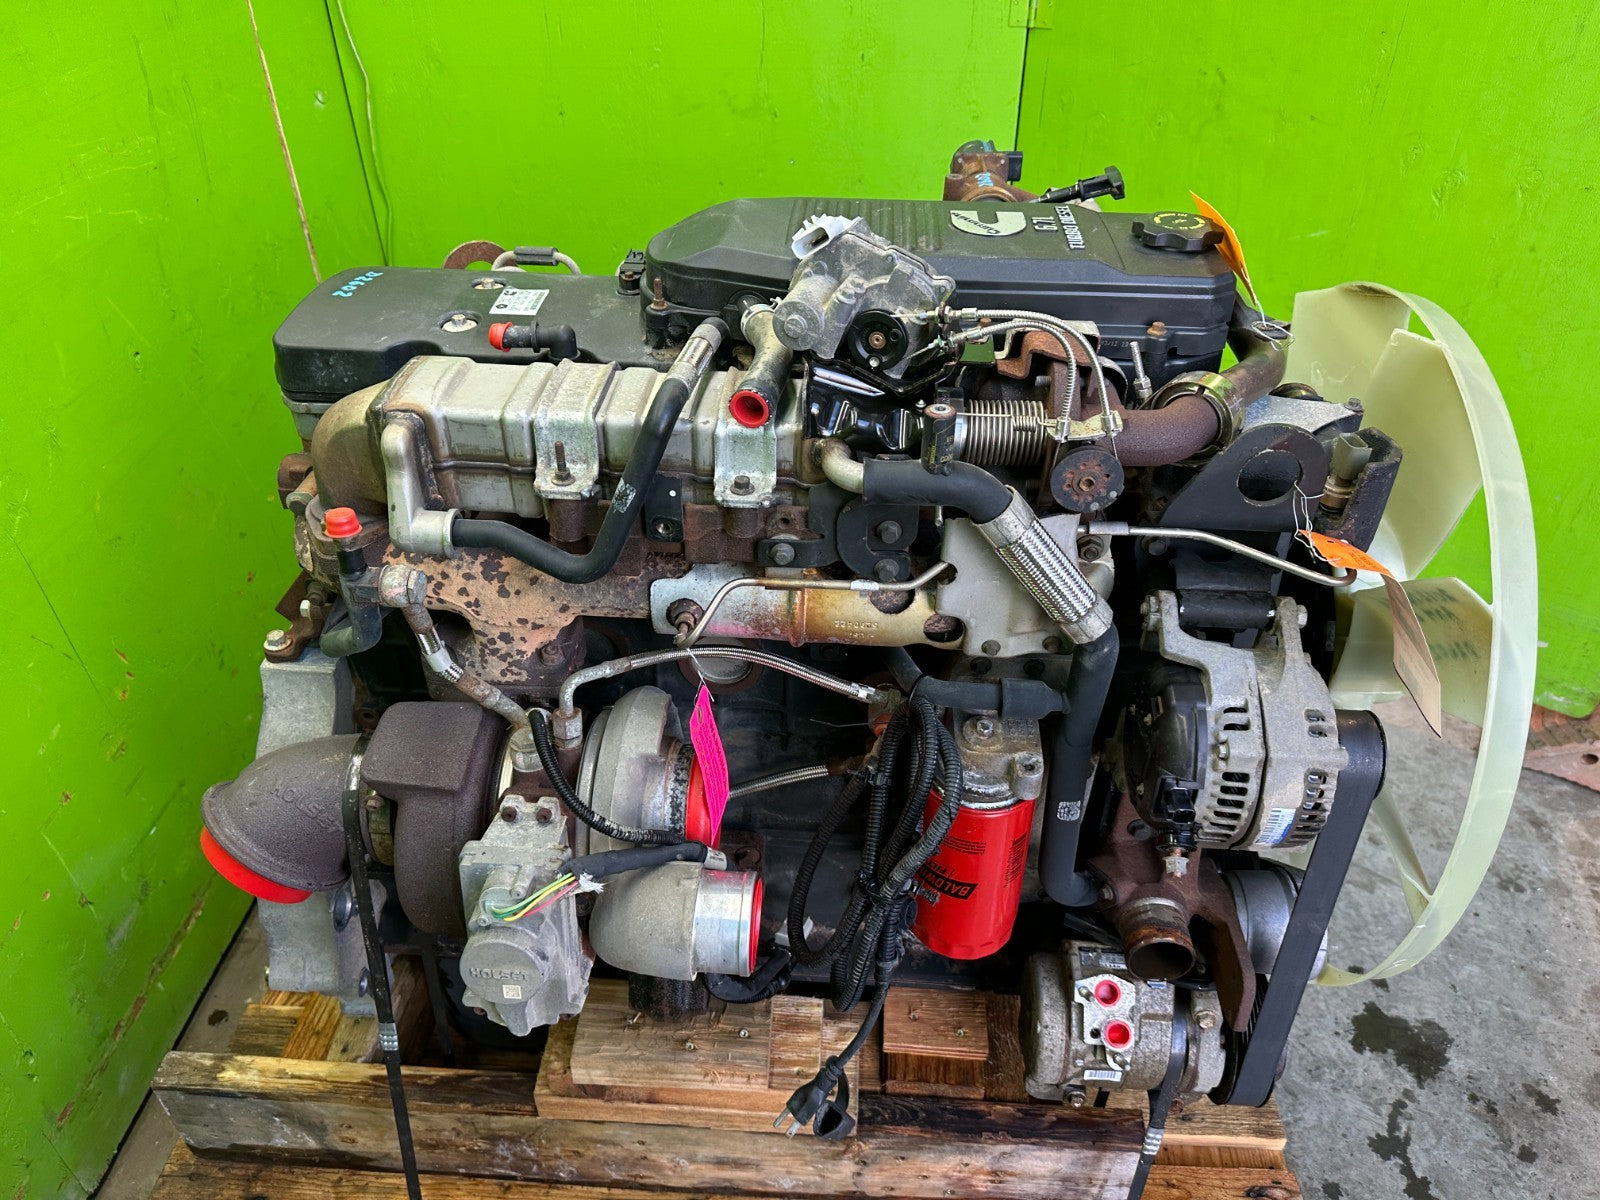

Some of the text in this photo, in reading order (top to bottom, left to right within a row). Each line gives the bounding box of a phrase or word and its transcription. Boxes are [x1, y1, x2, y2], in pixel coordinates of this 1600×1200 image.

[1031, 215, 1058, 231] 6.7L
[1054, 205, 1086, 250] TURBO DIESEL
[469, 967, 528, 981] HOLSET
